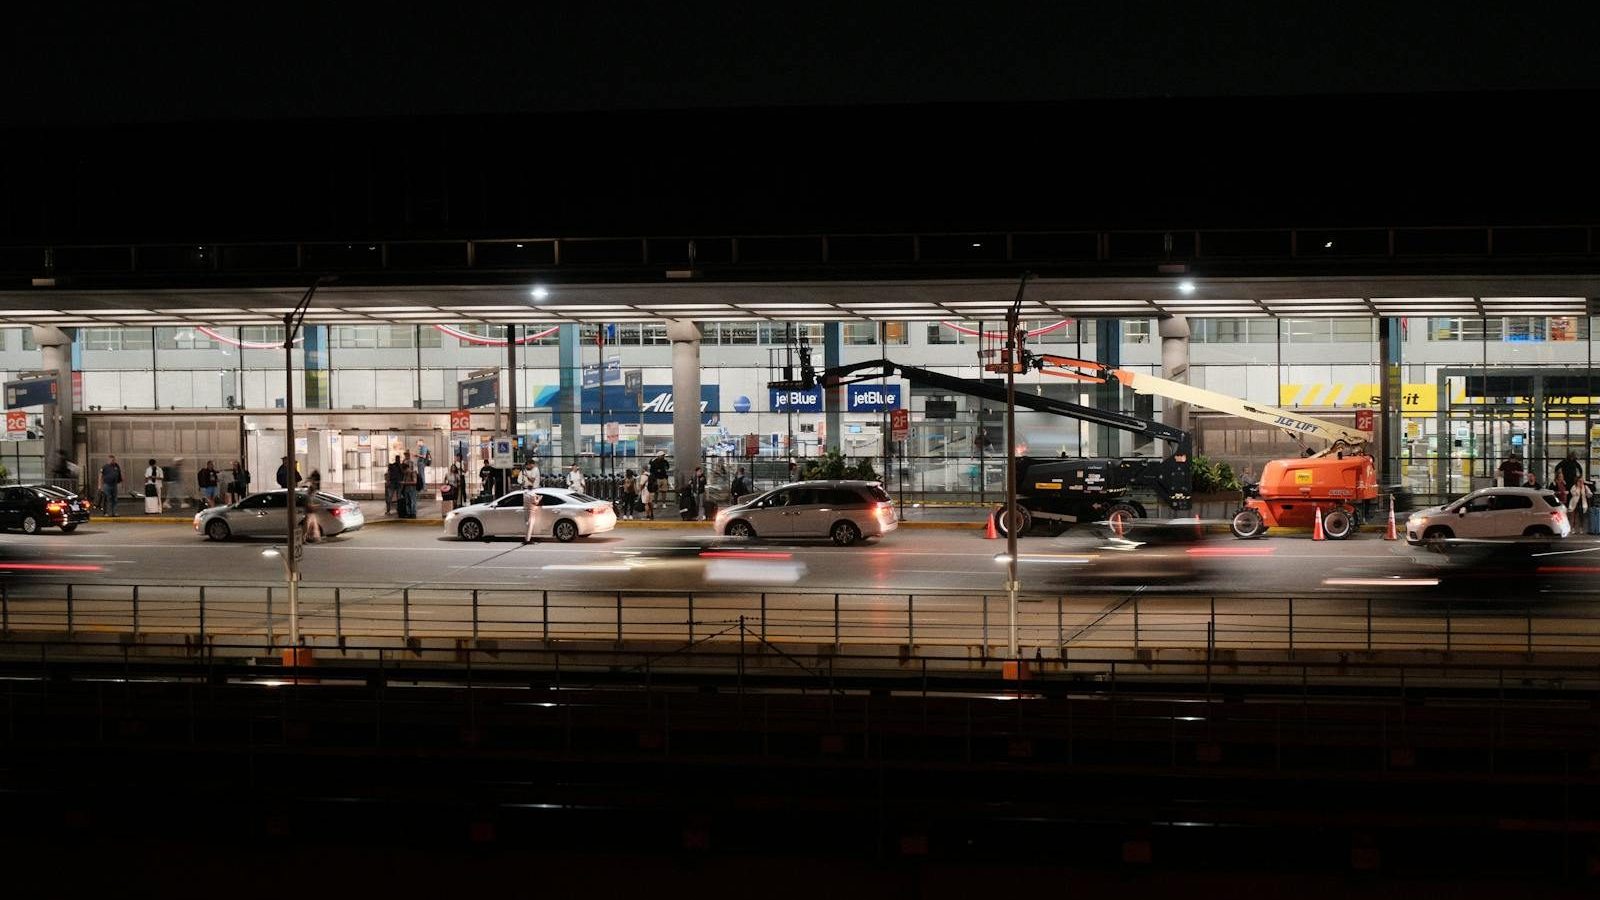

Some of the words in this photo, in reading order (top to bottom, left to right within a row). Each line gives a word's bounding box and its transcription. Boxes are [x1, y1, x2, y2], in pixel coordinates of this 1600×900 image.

[853, 391, 894, 407] jetBlue
[8, 418, 25, 430] 2G
[452, 418, 469, 429] 2G
[893, 416, 907, 428] 2F
[1274, 416, 1294, 426] JLG
[1295, 421, 1318, 433] LIFT
[1358, 417, 1372, 430] 2F
